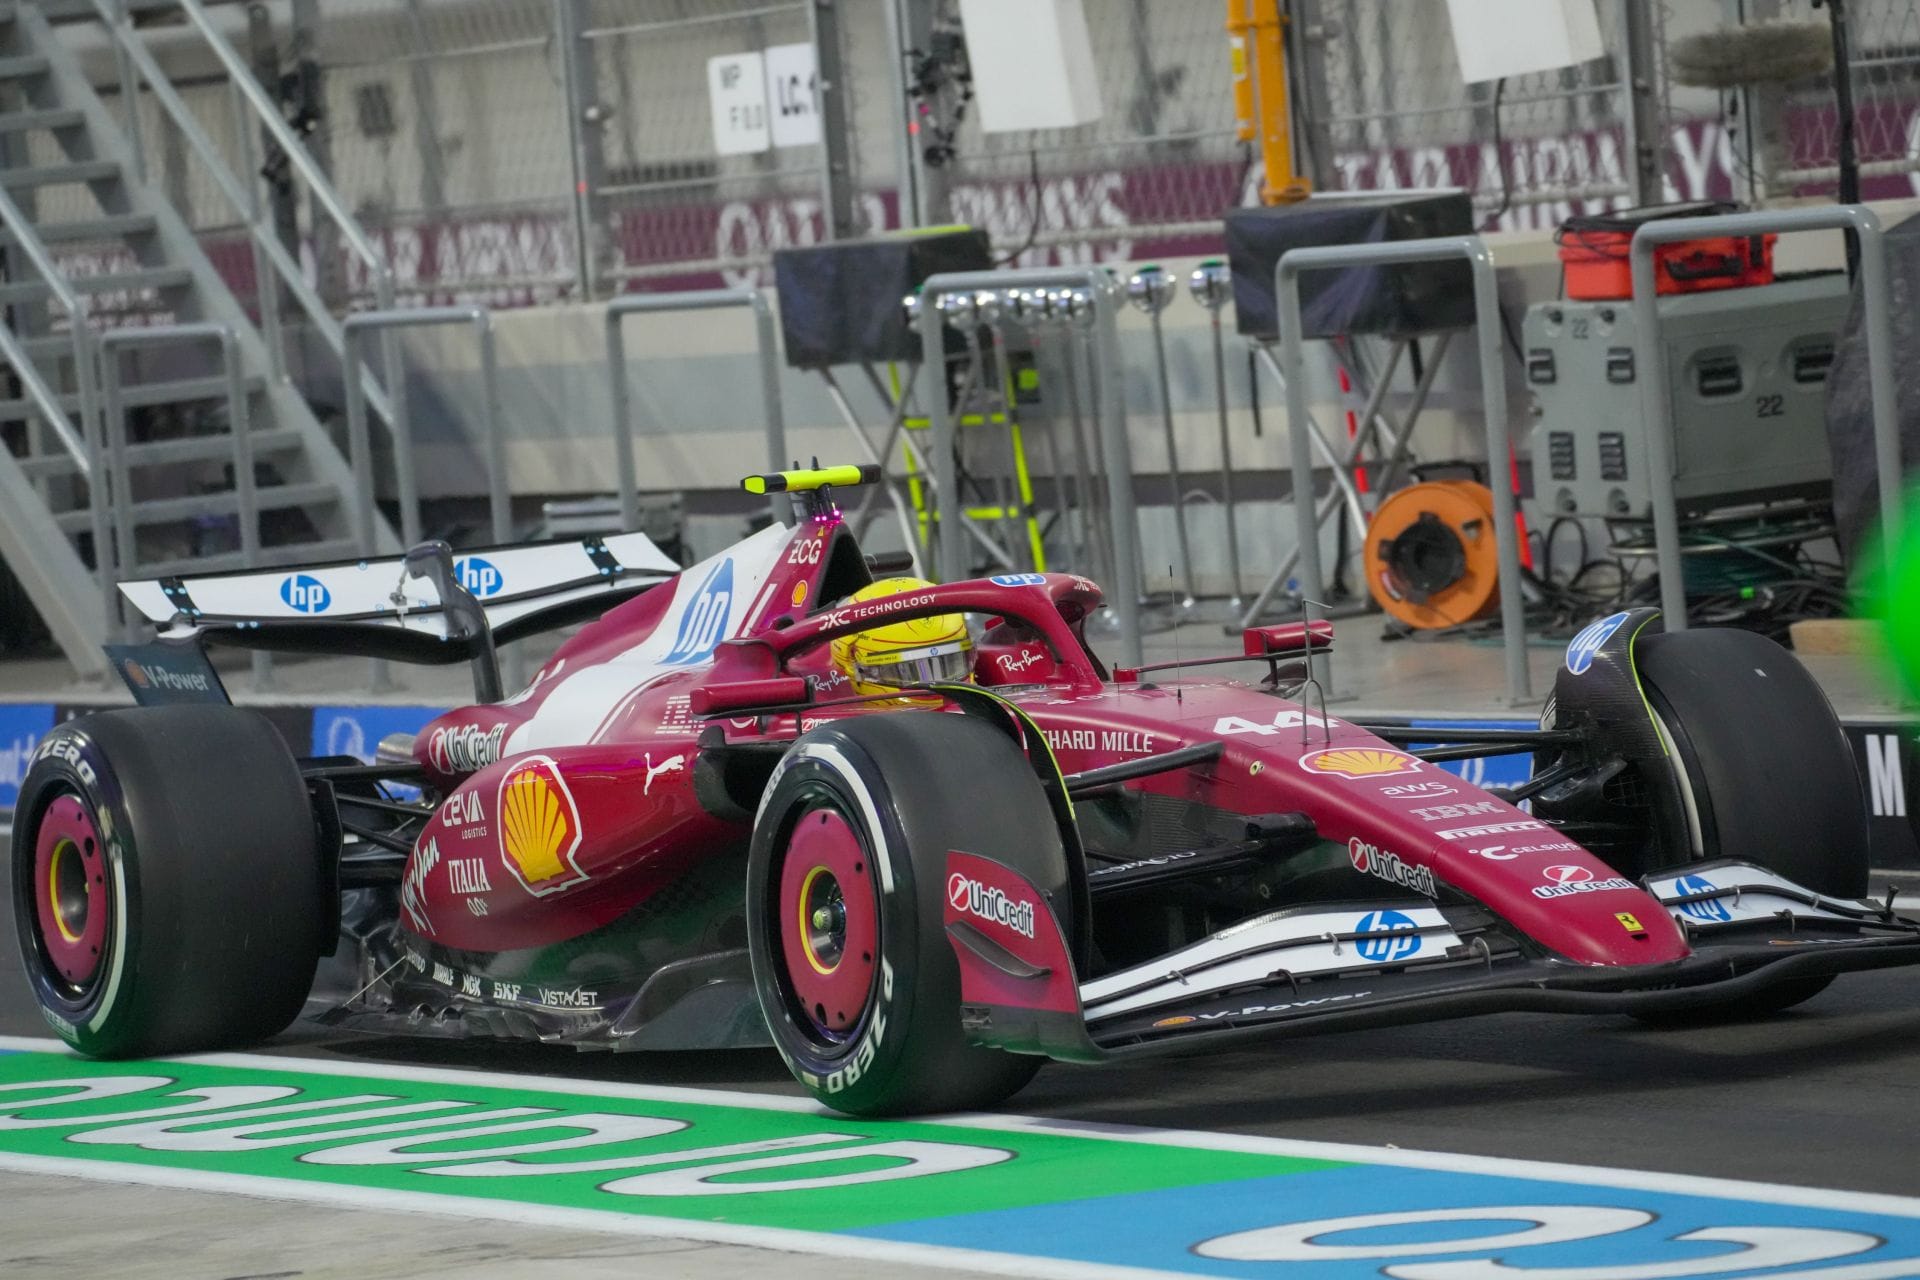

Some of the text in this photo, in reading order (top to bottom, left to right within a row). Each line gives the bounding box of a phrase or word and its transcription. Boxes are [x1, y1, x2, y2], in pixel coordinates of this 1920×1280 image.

[1572, 318, 1590, 340] 22
[1756, 394, 1785, 418] 22
[788, 539, 823, 565] ZCG
[462, 558, 497, 596] hp
[289, 576, 327, 613] hp
[819, 594, 937, 631] DXC TECHNOLOGY
[996, 649, 1044, 673] Ray-Ban
[141, 665, 209, 691] V-Power
[1213, 709, 1340, 736] 44
[451, 724, 507, 772] UniCredit
[1102, 731, 1153, 753] MILLE
[39, 739, 98, 786] ZERO
[1380, 780, 1448, 796] aws
[1408, 801, 1507, 822] IBM
[461, 826, 487, 840] LOGISTICS
[448, 857, 492, 894] ITALIA
[1367, 844, 1438, 899] UniCredit
[1533, 876, 1640, 899] UniCredit
[970, 880, 1034, 939] UniCredit
[493, 982, 521, 1001] SKF
[1197, 990, 1372, 1020] V-Power
[826, 954, 894, 1095] P ZERO
